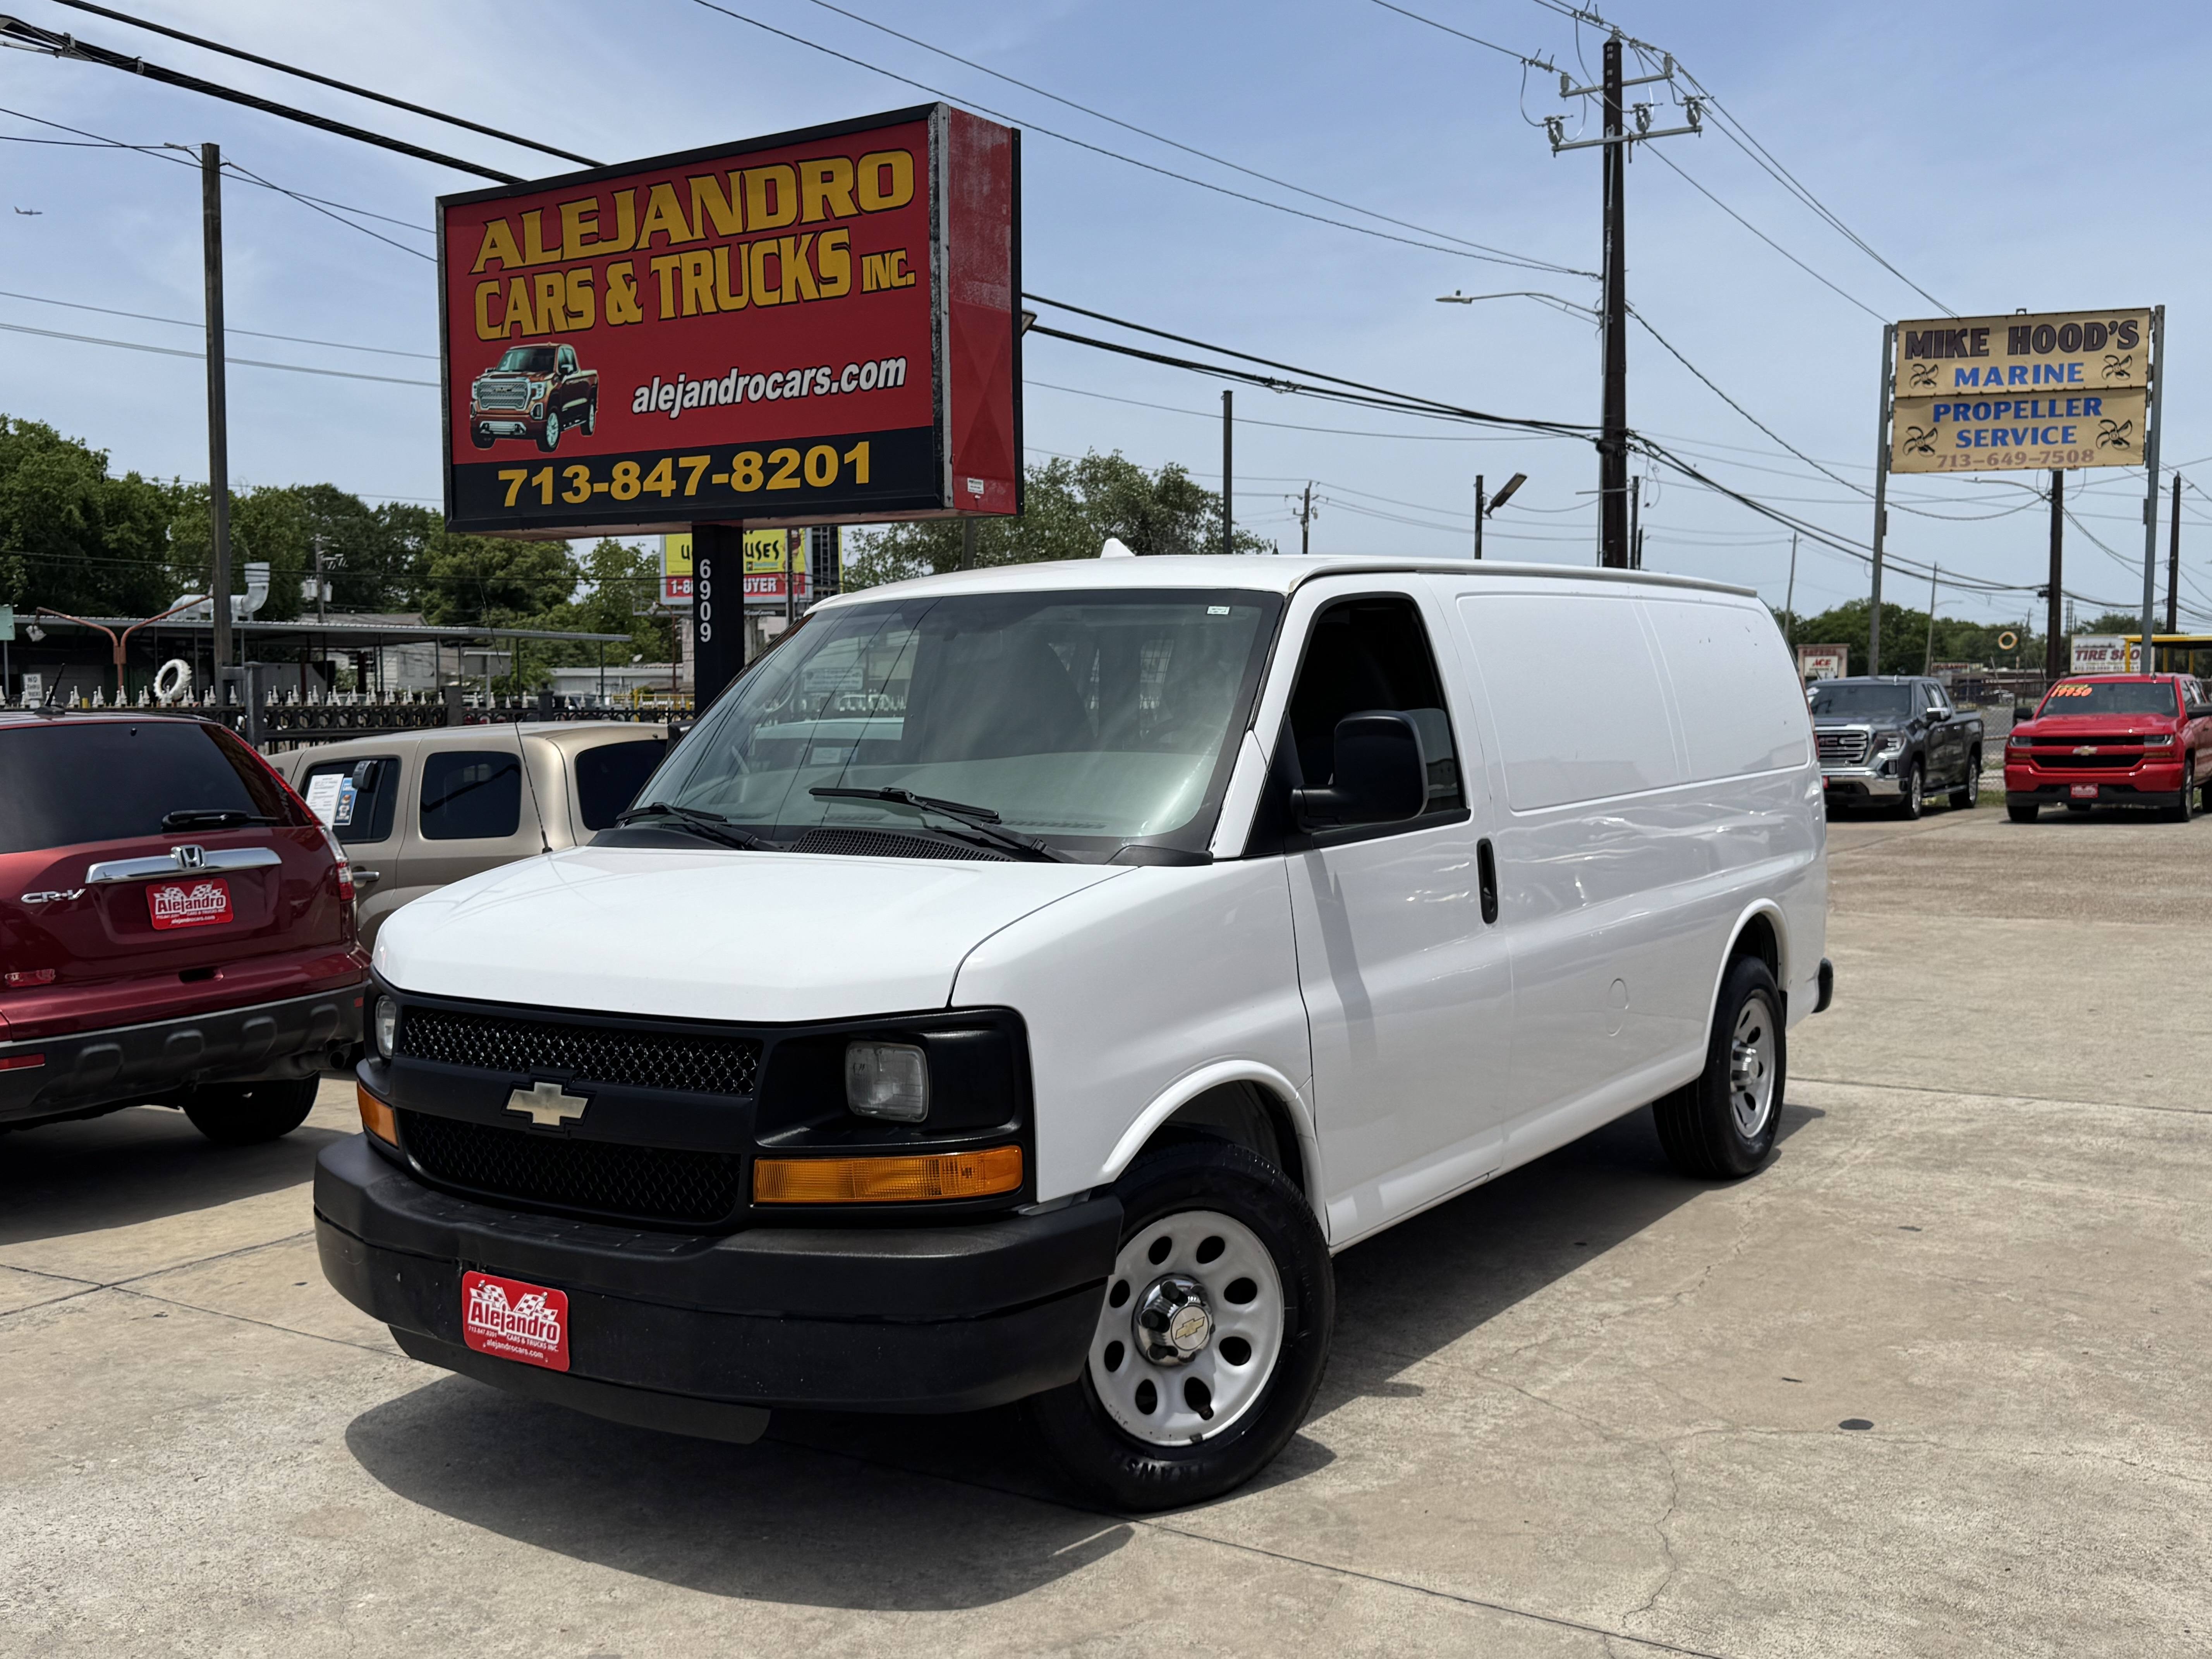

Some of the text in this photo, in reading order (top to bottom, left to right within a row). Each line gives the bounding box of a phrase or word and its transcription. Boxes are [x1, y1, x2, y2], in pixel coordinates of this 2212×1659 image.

[469, 149, 915, 276] ALEJANDRO
[474, 226, 916, 341] CARS & TRUCKS INC.
[1905, 319, 2140, 360] MIKE HOOD'S
[1954, 362, 2084, 387] MARINE
[632, 356, 907, 419] alejandrocars.com
[1933, 397, 2102, 422] PROPELLER
[1955, 425, 2077, 448] SERVICE
[1937, 449, 2095, 468] 713-649-7508
[497, 441, 871, 507] 713-847-8201
[699, 558, 711, 642] 6909
[2075, 649, 2107, 661] TIRE
[21, 888, 87, 904] CR-V
[156, 895, 225, 913] Alejandro
[470, 1301, 558, 1341] Alejandro
[486, 1339, 544, 1358] alejandrocars.com
[507, 1333, 520, 1343] CARS
[527, 1339, 546, 1350] TRUCKS
